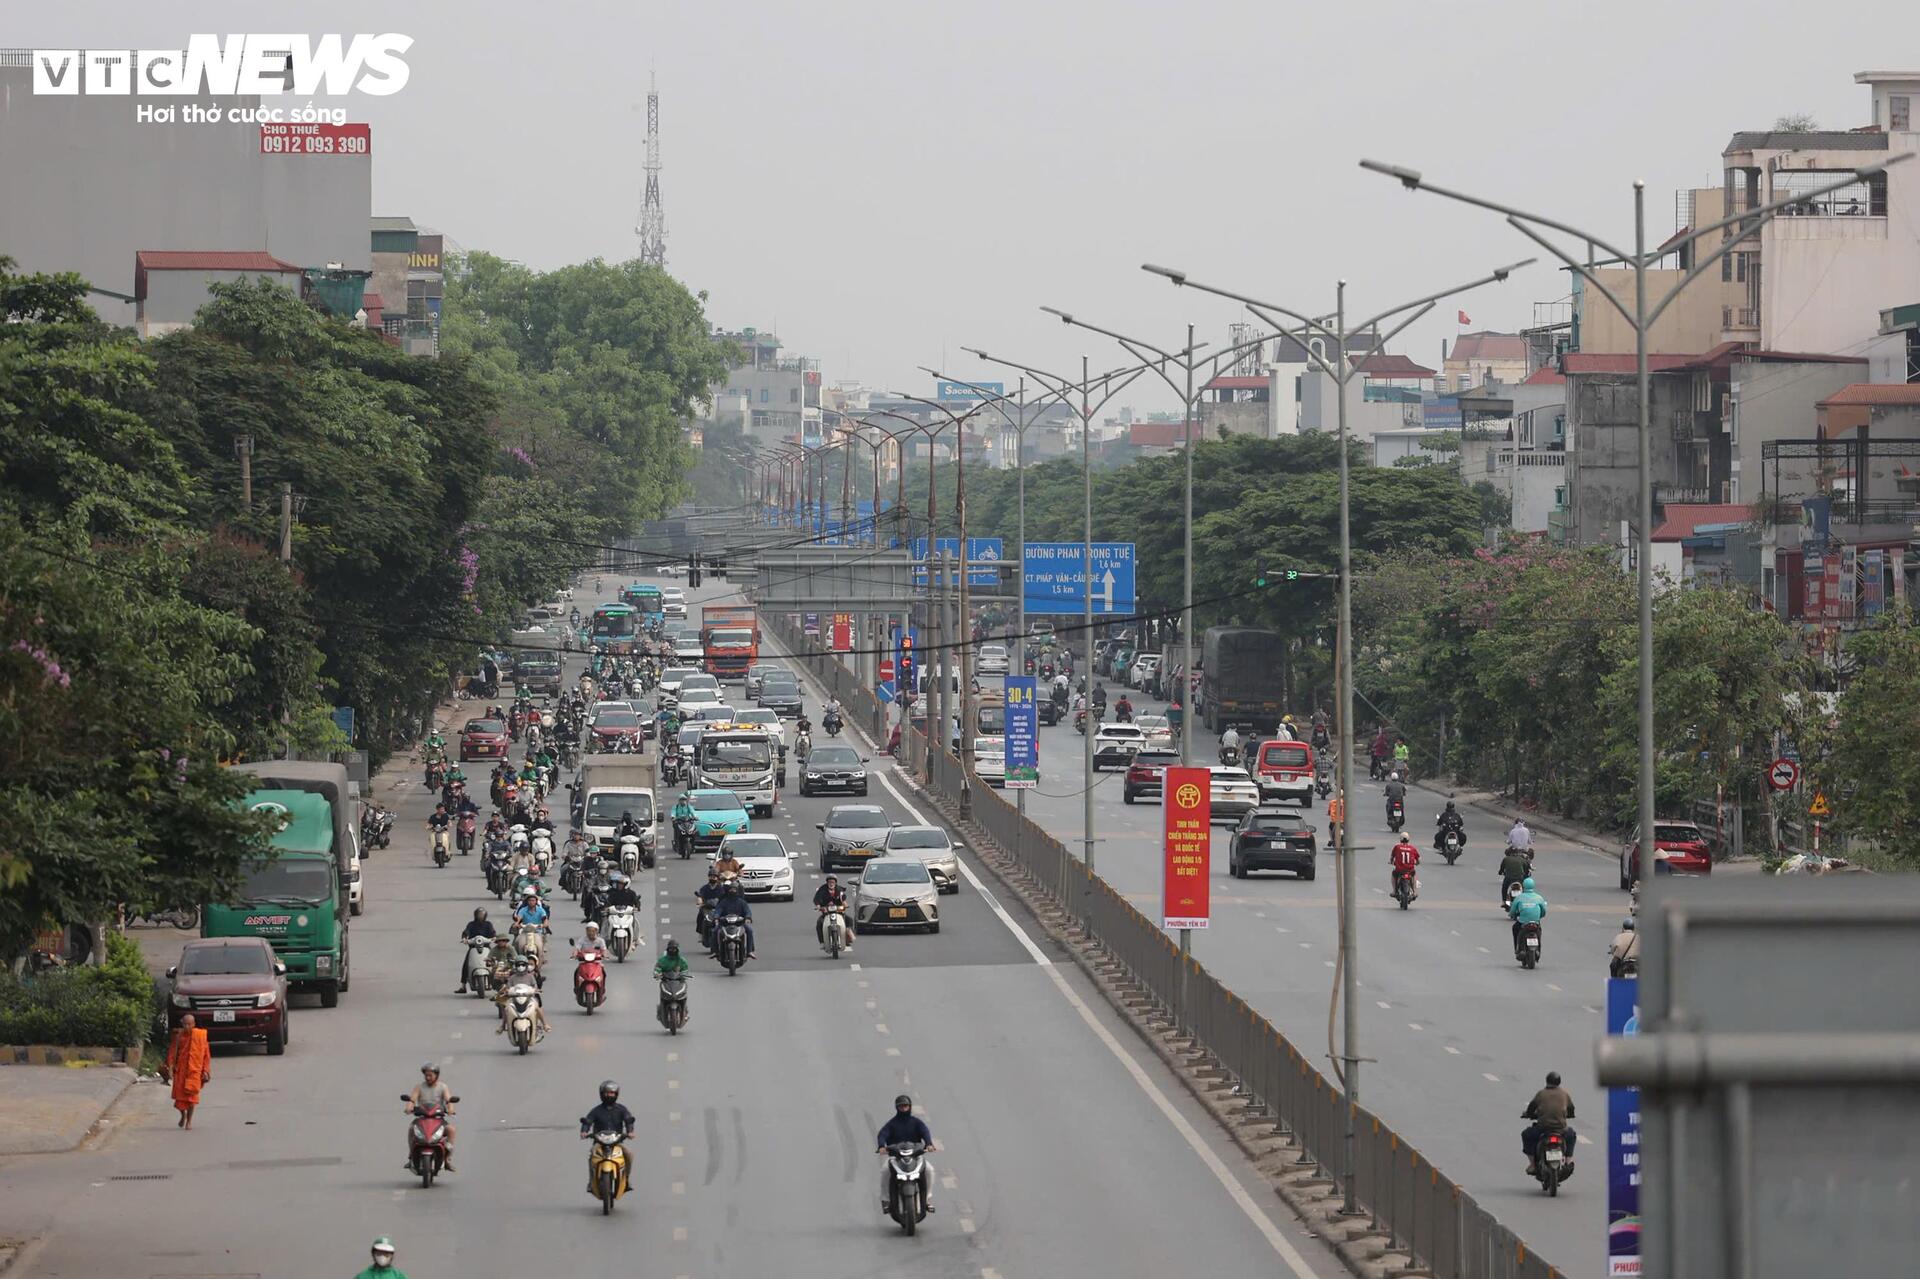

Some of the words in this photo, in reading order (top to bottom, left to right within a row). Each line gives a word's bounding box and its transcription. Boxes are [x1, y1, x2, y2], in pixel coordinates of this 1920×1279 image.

[263, 125, 289, 135] CHO
[290, 124, 320, 135] THUÊ
[263, 136, 301, 153] 0912
[305, 136, 334, 153] 093
[338, 136, 367, 153] 390
[1025, 545, 1055, 559] ĐƯỜNG
[1057, 547, 1080, 559] PHAN
[1110, 560, 1121, 569] km
[1036, 571, 1053, 583] PHÁP
[1286, 570, 1298, 580] 32
[1063, 585, 1074, 594] km
[1401, 851, 1410, 864] 11
